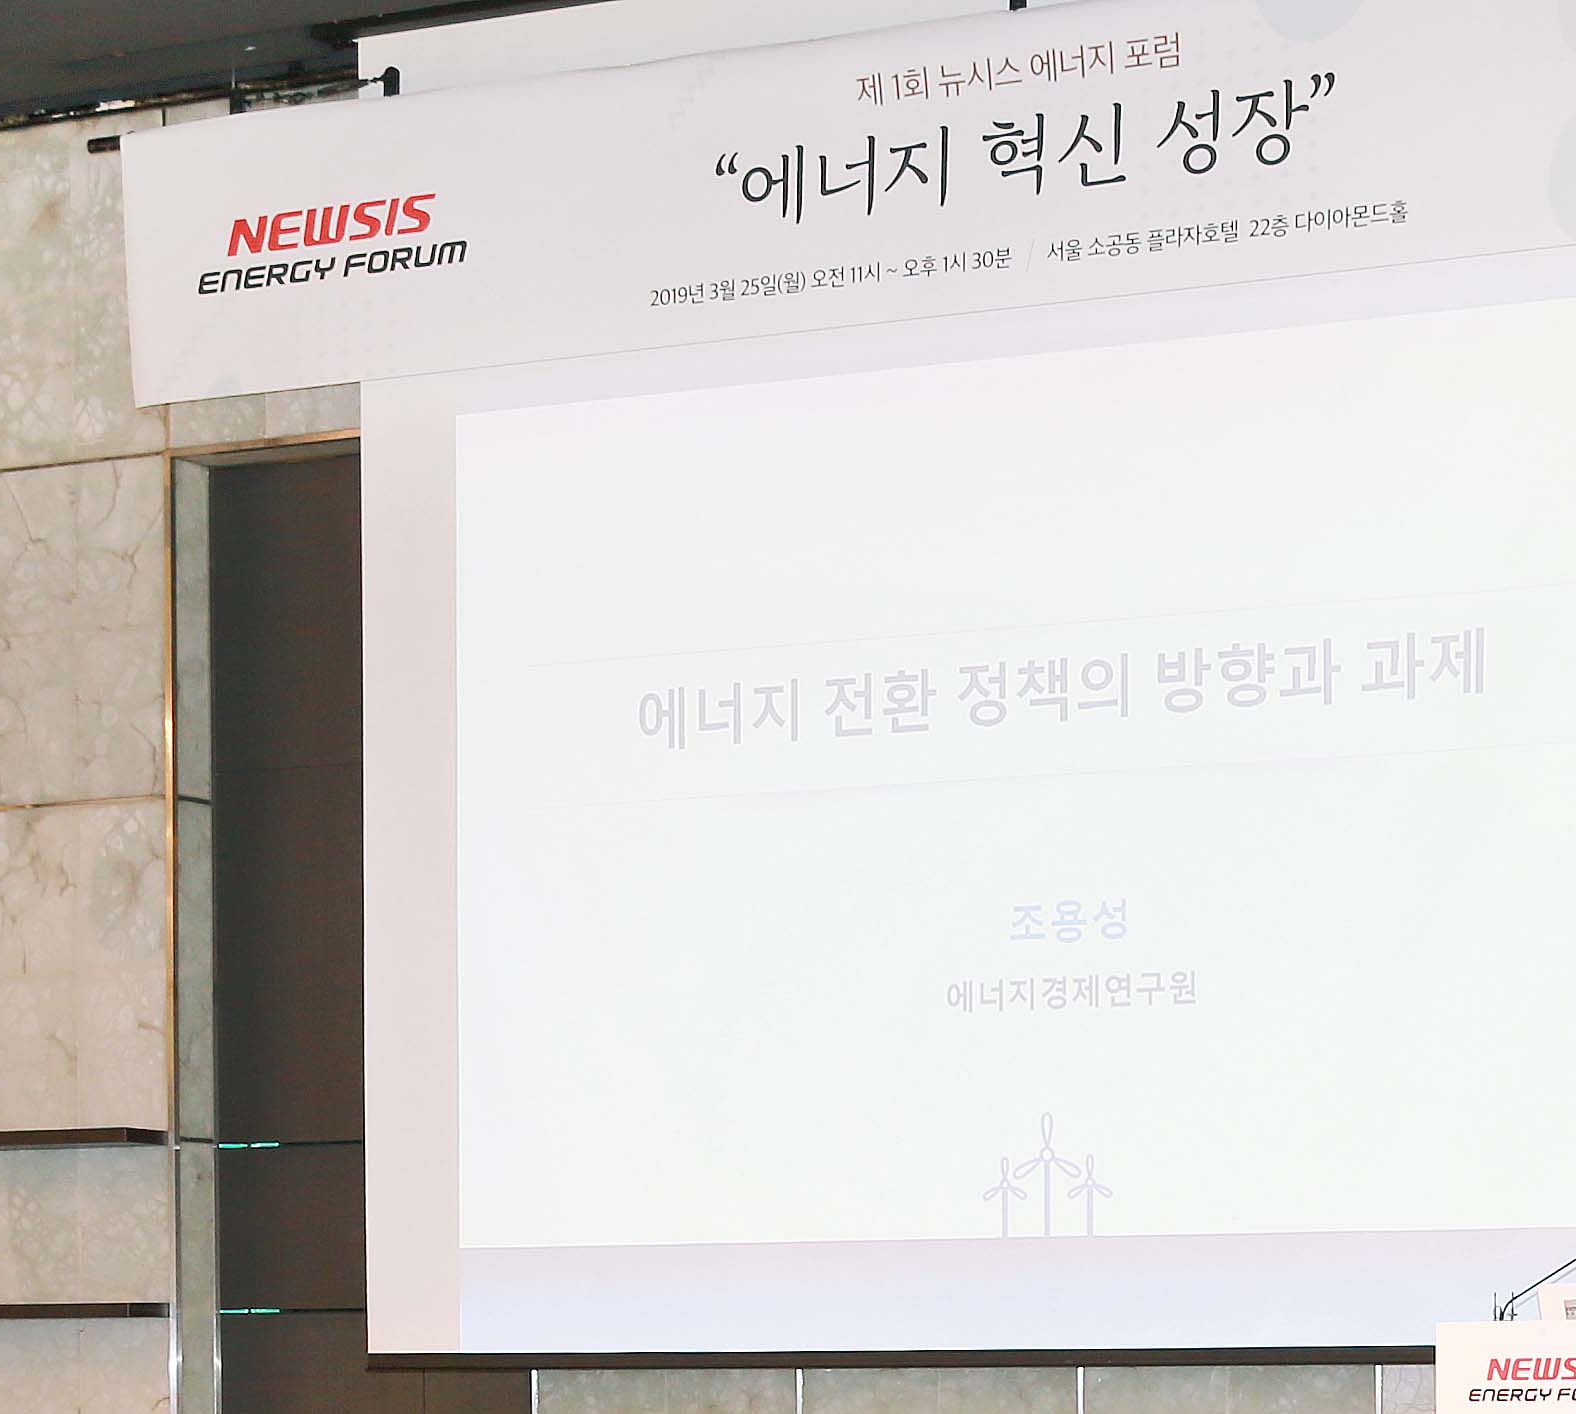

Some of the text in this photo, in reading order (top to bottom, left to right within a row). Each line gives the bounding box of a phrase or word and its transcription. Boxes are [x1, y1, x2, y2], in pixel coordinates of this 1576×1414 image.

[857, 32, 1179, 105] 제 1회 뉴시스 에너지 포럼
[716, 72, 1335, 224] “에너지 혁신 성장”
[227, 193, 437, 257] NEWSIS
[1048, 200, 1408, 261] 서울 소공동 플라자호텔 22층 다이아몬드홀
[199, 241, 467, 294] ENERGY FORUM
[651, 283, 703, 306] 2019년
[710, 280, 734, 301] 3월
[741, 272, 805, 296] 25일(월)
[811, 266, 844, 288] 오전
[851, 262, 879, 283] 11시
[903, 256, 937, 277] 오후
[944, 252, 965, 272] 1시
[973, 248, 1011, 269] 30분
[639, 628, 1484, 749] 에너지 전환 정책의 방향과 과제
[1010, 899, 1127, 943] 조용성
[947, 970, 1196, 1013] 에너지경제연구원
[1469, 1389, 1551, 1401] ENERGY
